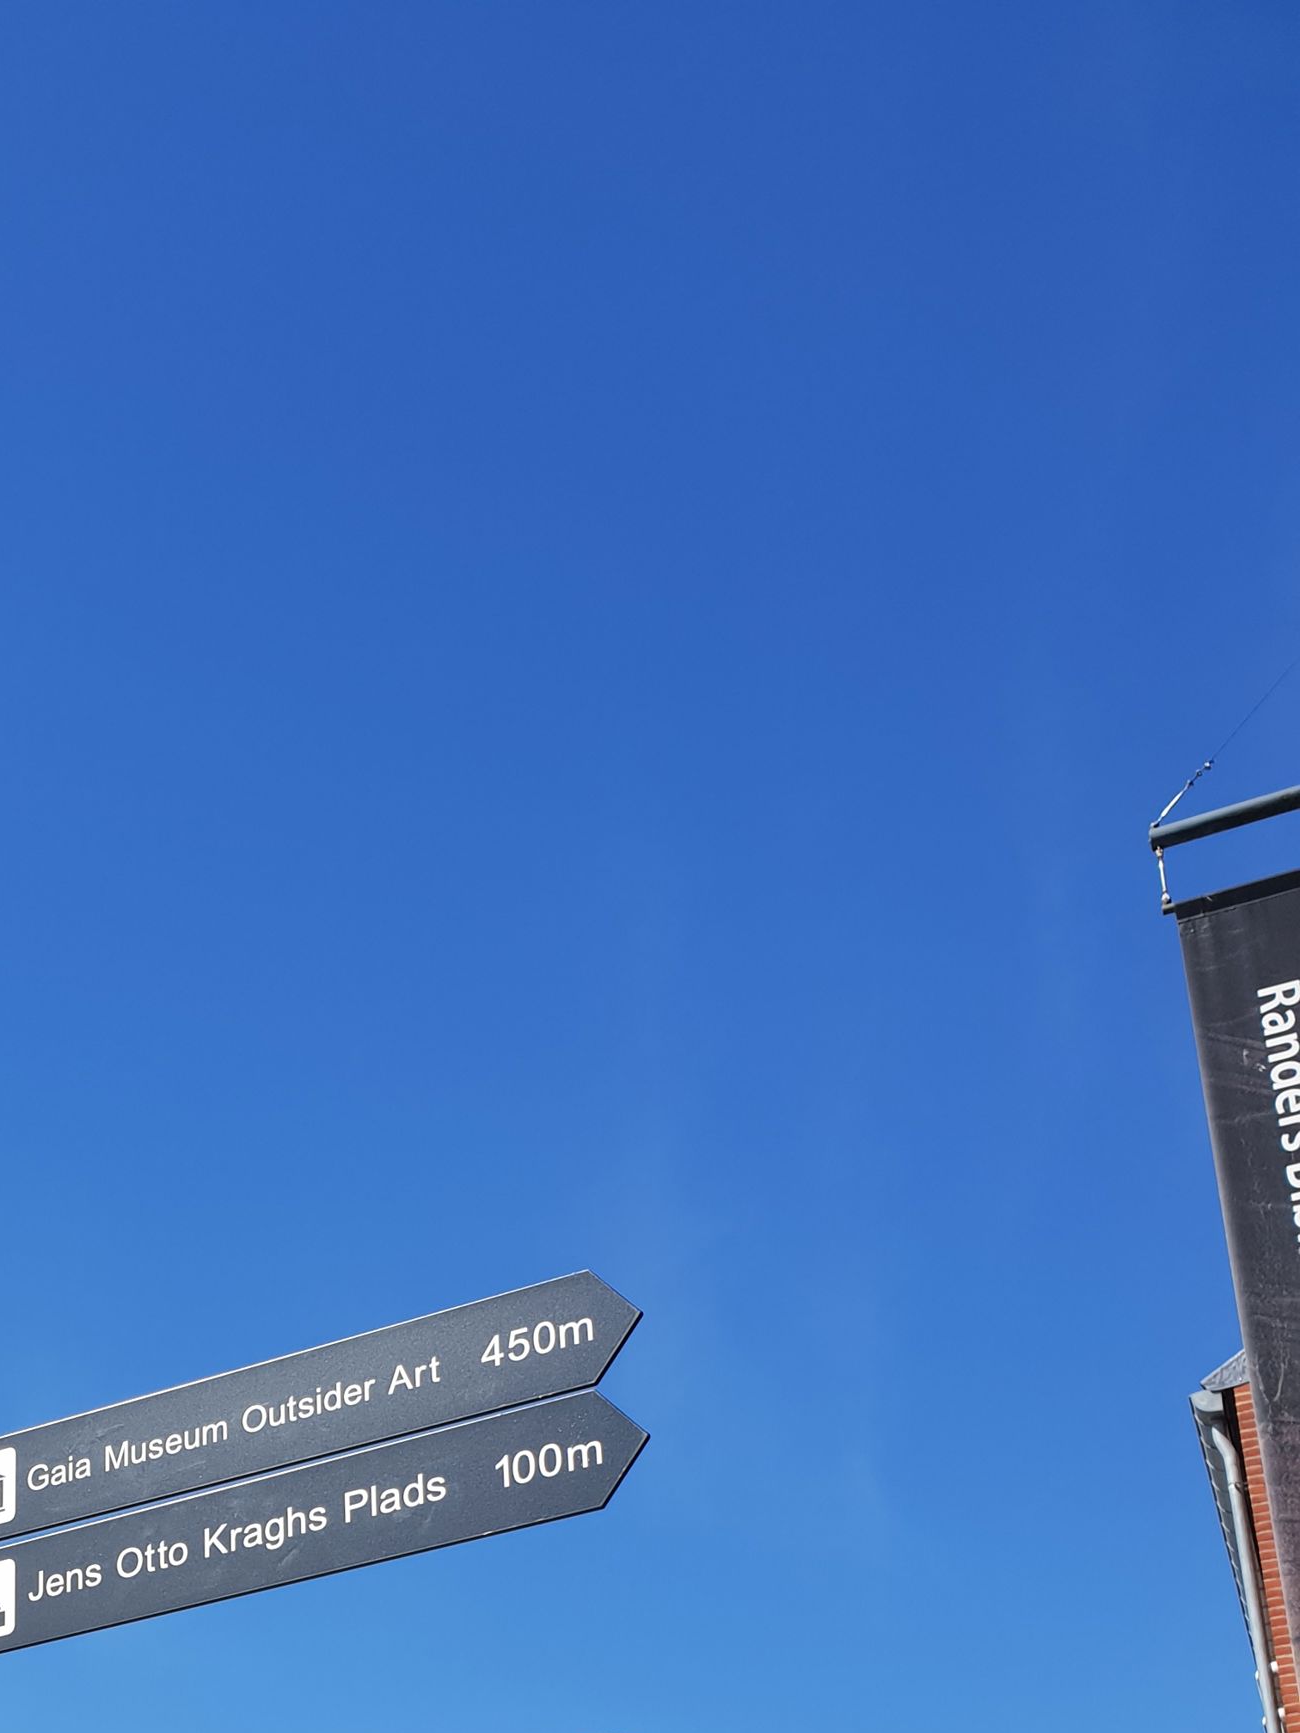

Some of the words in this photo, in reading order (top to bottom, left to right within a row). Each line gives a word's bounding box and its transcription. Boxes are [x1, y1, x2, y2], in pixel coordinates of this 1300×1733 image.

[26, 1454, 92, 1491] Gaia
[104, 1418, 229, 1473] Museum
[241, 1378, 377, 1434] Outsider
[387, 1355, 442, 1396] Art
[480, 1317, 595, 1367] 450m
[27, 1563, 103, 1602] Jens
[116, 1539, 189, 1579] Otto
[203, 1506, 328, 1559] Kraghs
[344, 1472, 447, 1524] Plads
[494, 1440, 603, 1488] 100m
